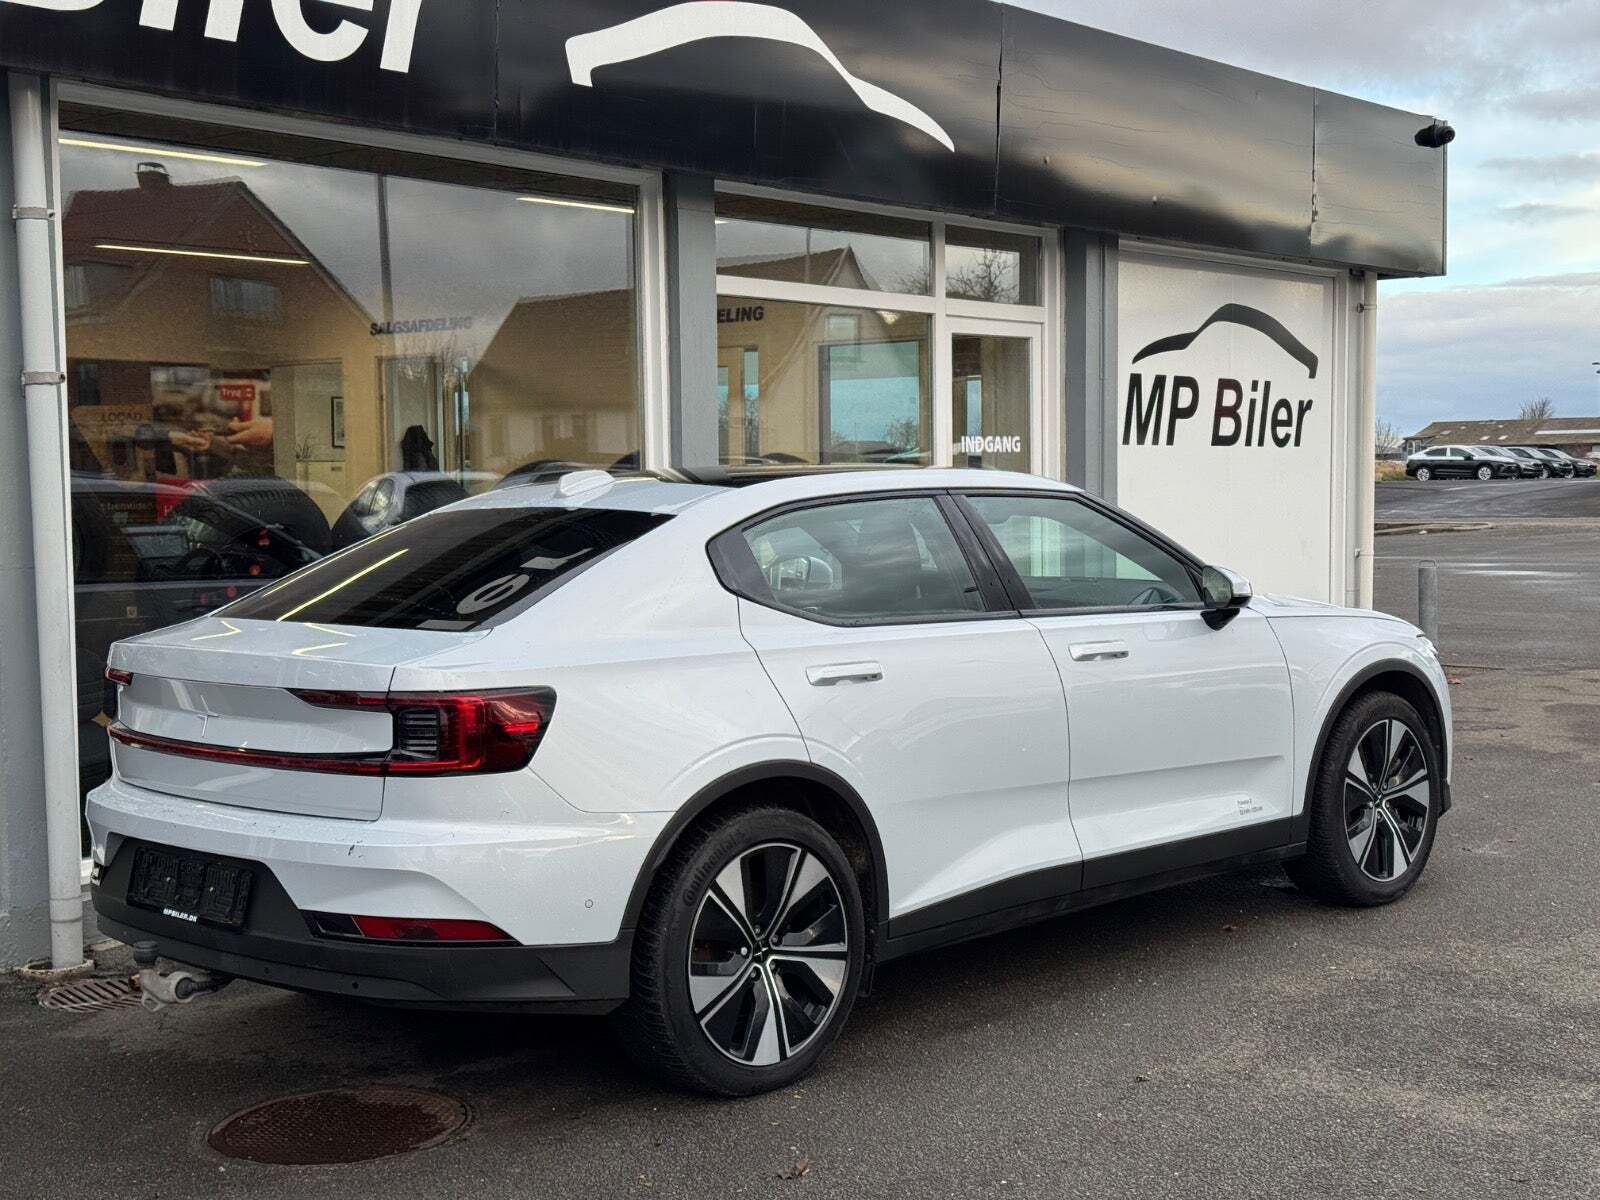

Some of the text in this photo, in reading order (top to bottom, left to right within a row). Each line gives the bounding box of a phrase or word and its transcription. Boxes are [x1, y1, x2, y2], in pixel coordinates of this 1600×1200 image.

[370, 316, 473, 336] SALGSAFDELING
[1122, 373, 1313, 448] MP Biler
[960, 435, 1022, 454] INDGANG
